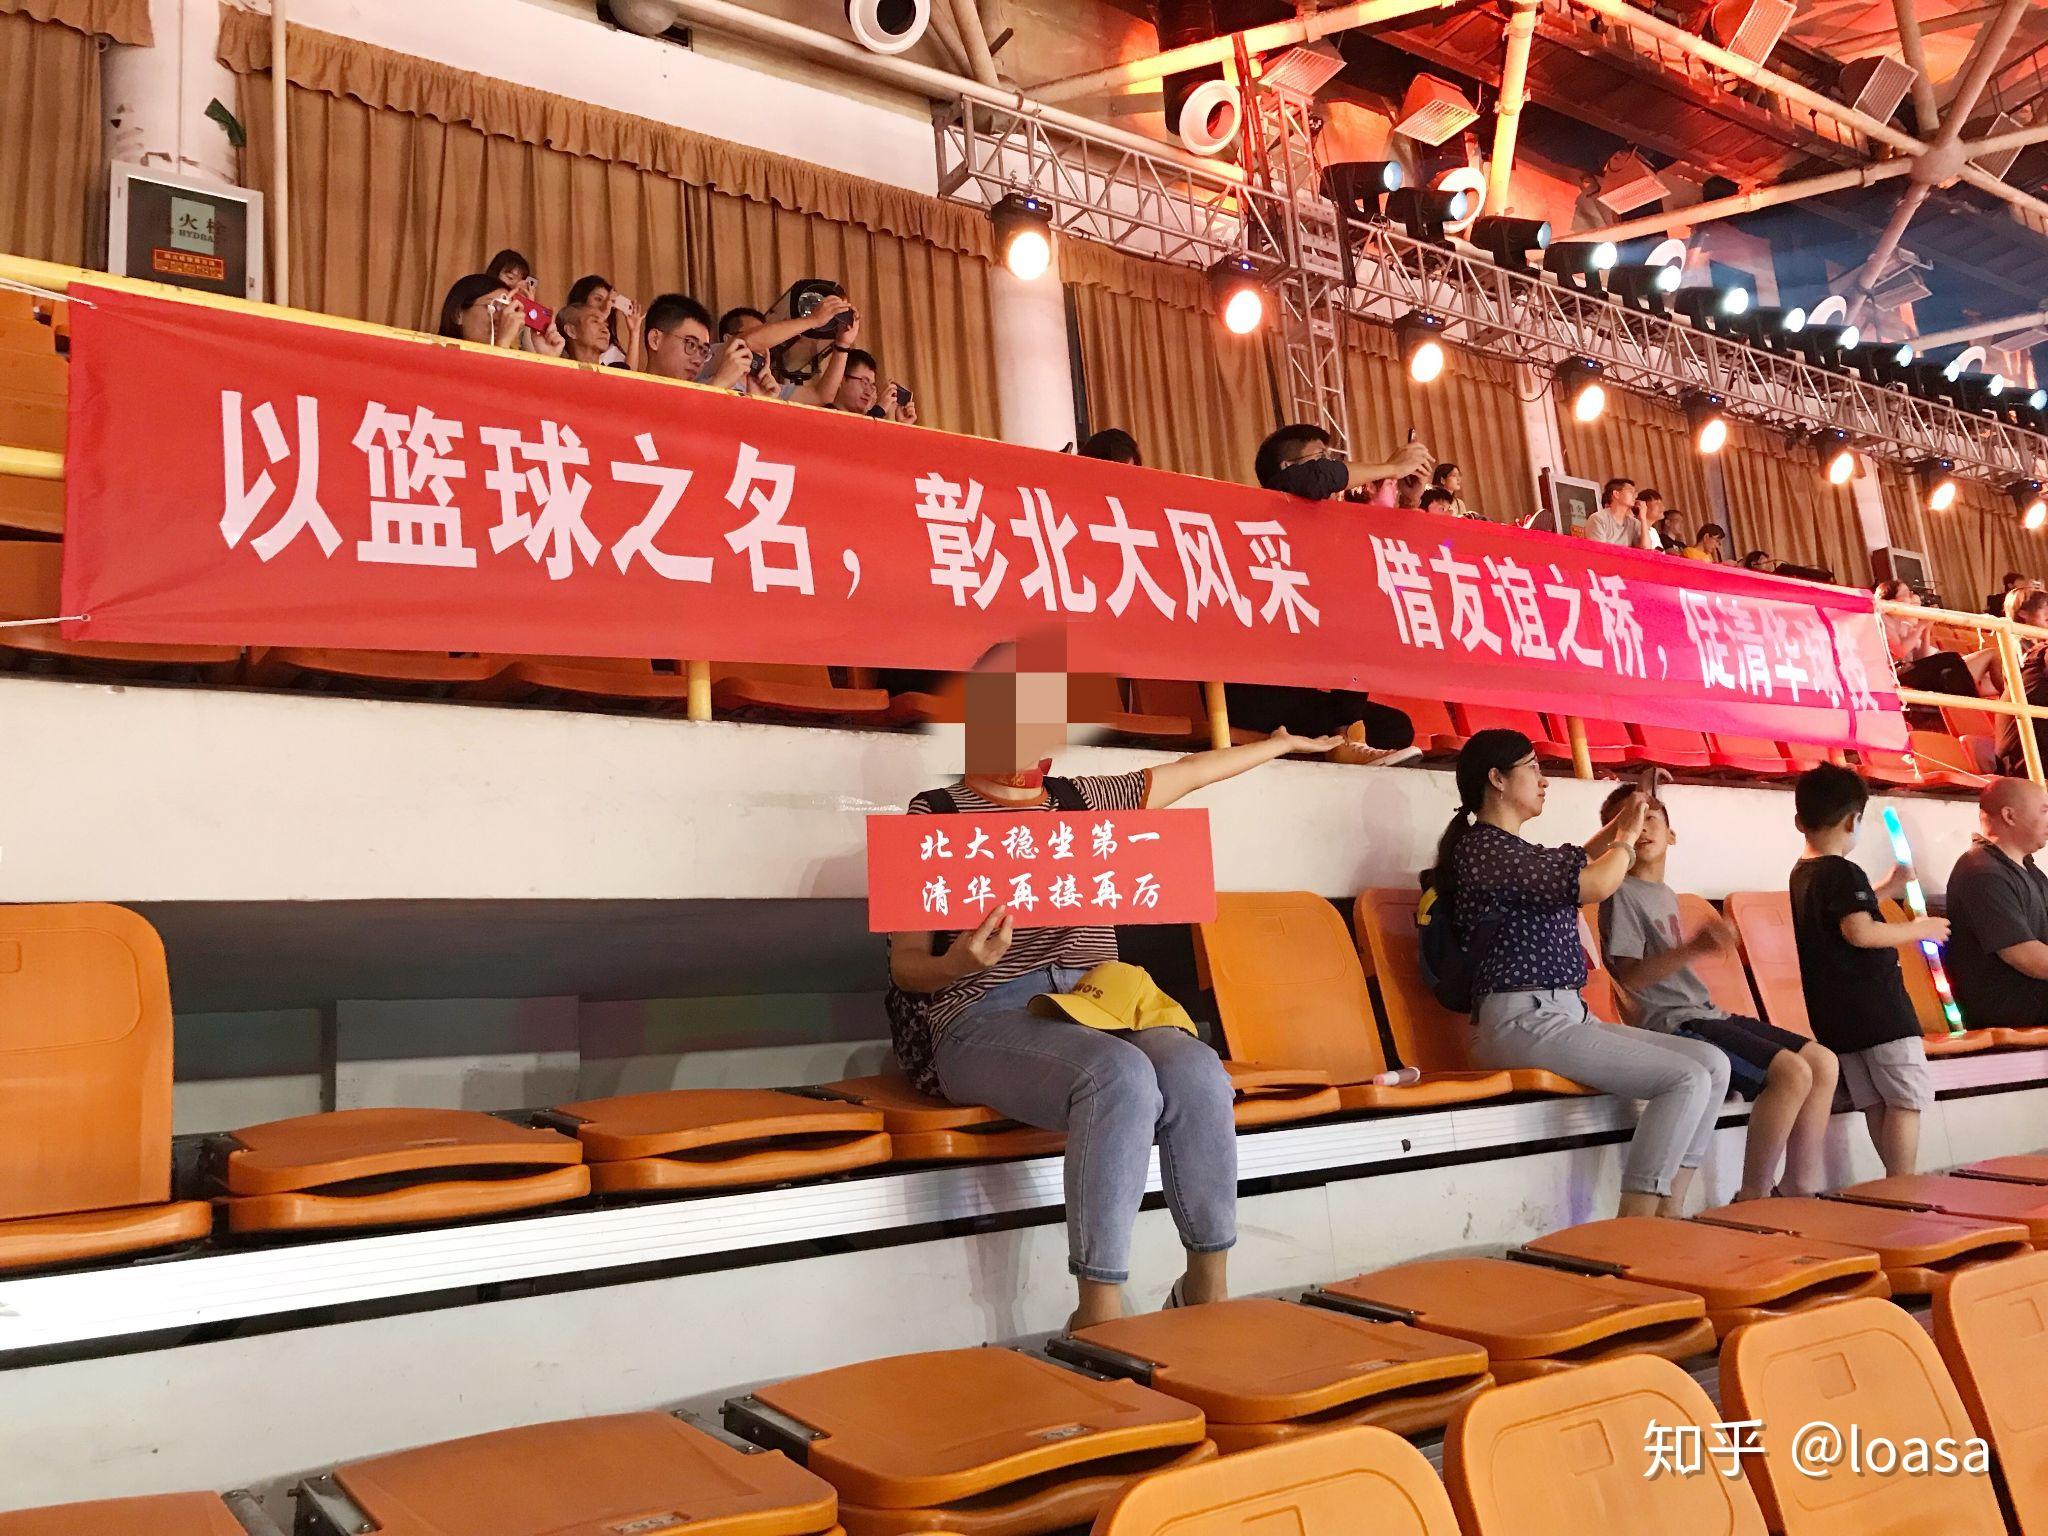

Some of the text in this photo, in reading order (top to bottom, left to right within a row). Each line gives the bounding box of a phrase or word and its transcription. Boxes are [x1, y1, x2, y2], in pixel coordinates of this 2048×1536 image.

[920, 819, 1161, 861] 北大稳坐第一
[920, 870, 1162, 916] 清华再接再厉
